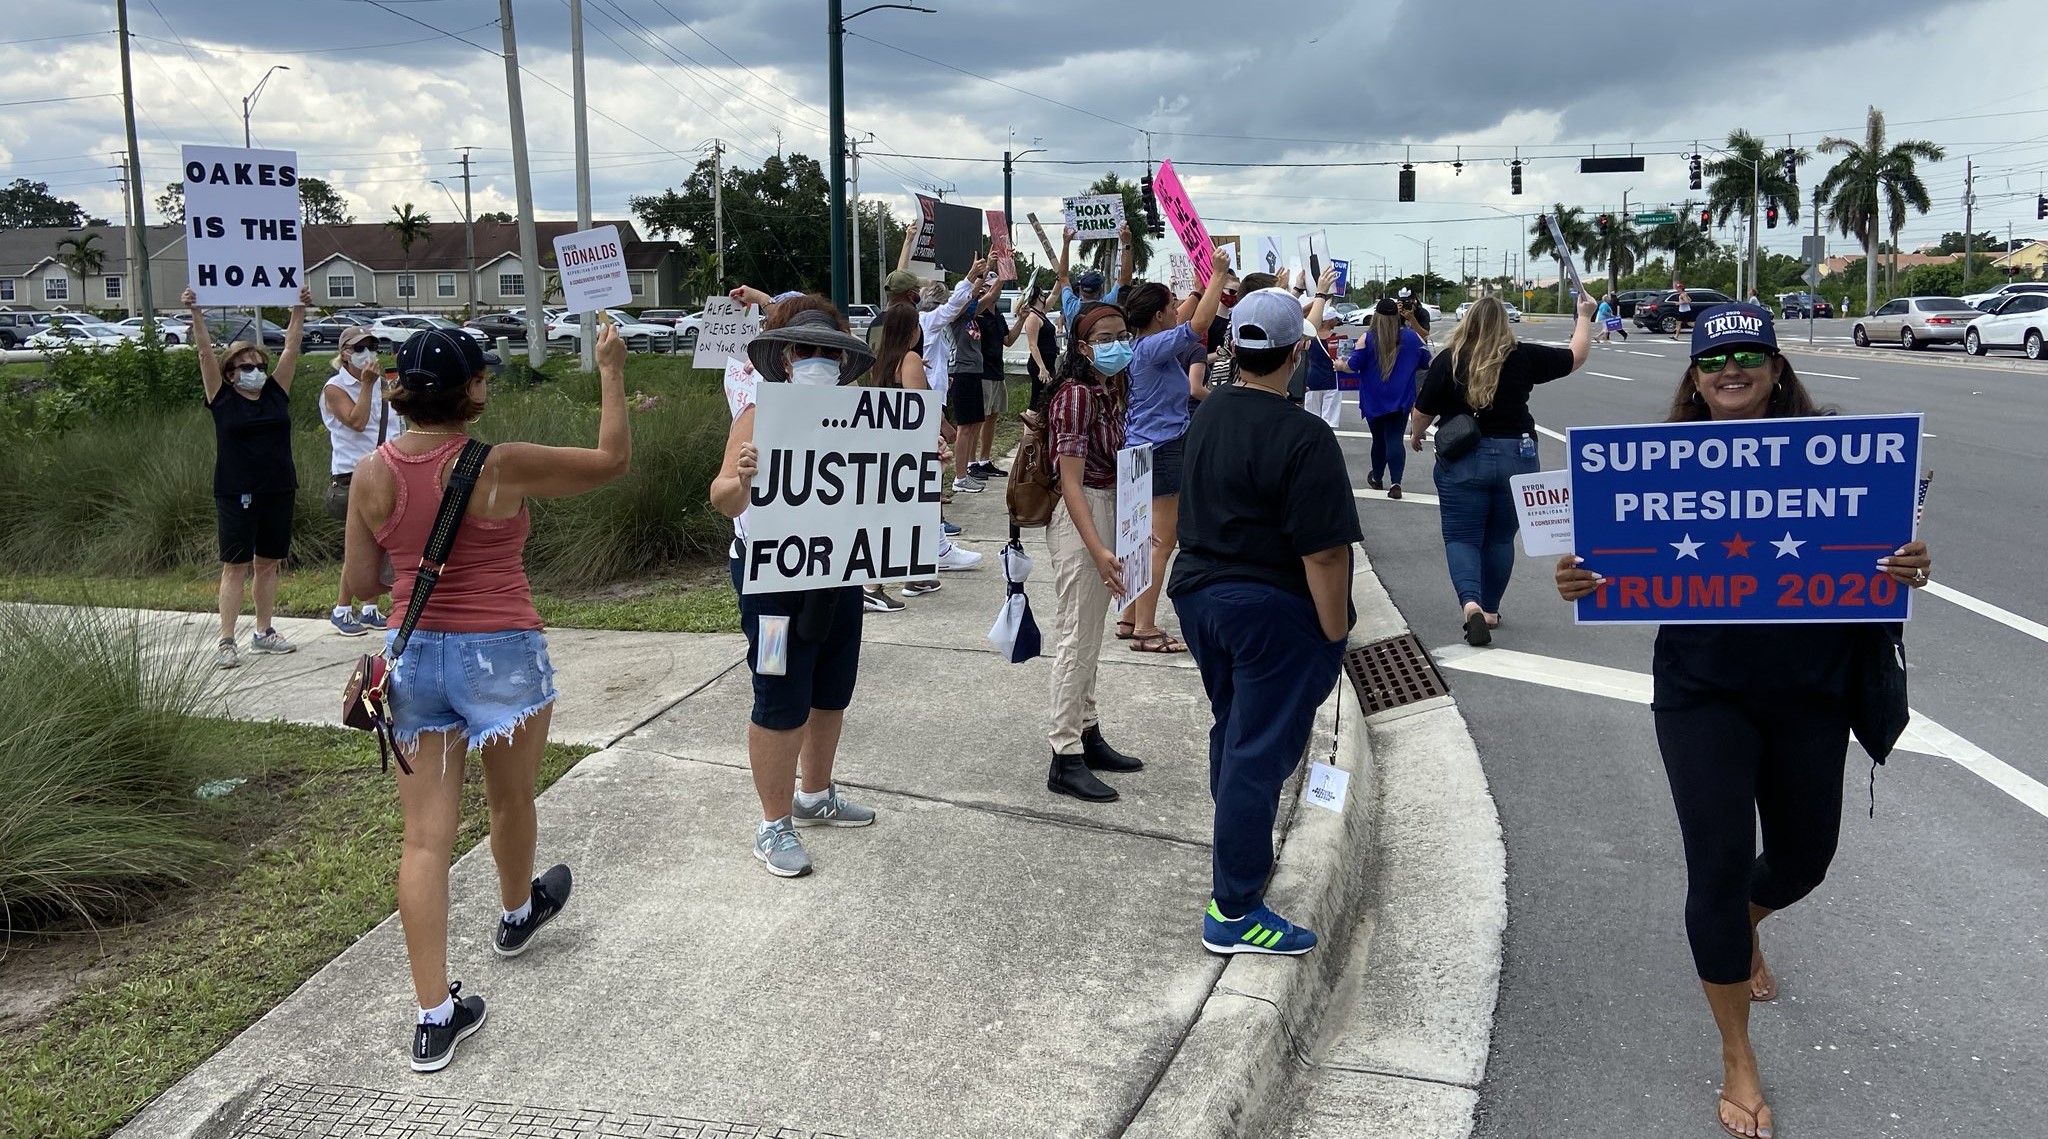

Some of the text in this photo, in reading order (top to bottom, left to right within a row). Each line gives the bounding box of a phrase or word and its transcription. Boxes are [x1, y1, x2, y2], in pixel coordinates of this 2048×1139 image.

[186, 161, 296, 187] OAKES
[1076, 218, 1117, 230] FARMS
[1174, 197, 1190, 227] WE
[192, 216, 297, 241] IS THE
[563, 243, 617, 267] DONALDS
[1334, 261, 1347, 270] OUR
[198, 264, 298, 288] HOAX
[704, 321, 758, 336] PLEASE STAY
[1704, 315, 1763, 336] TRUMP
[699, 342, 711, 353] ON
[716, 341, 736, 353] YOUR
[1580, 432, 1906, 473] SUPPORT OUR
[750, 448, 942, 507] JUSTICE
[1522, 484, 1545, 492] BYRON
[1524, 488, 1569, 507] DONA
[1615, 486, 1869, 522] PRESIDENT
[1528, 509, 1563, 517] REPUBLICAN
[1535, 518, 1570, 527] CONSERVATIVE
[750, 525, 937, 582] FOR ALL
[1594, 572, 1897, 609] TRUMP 2020
